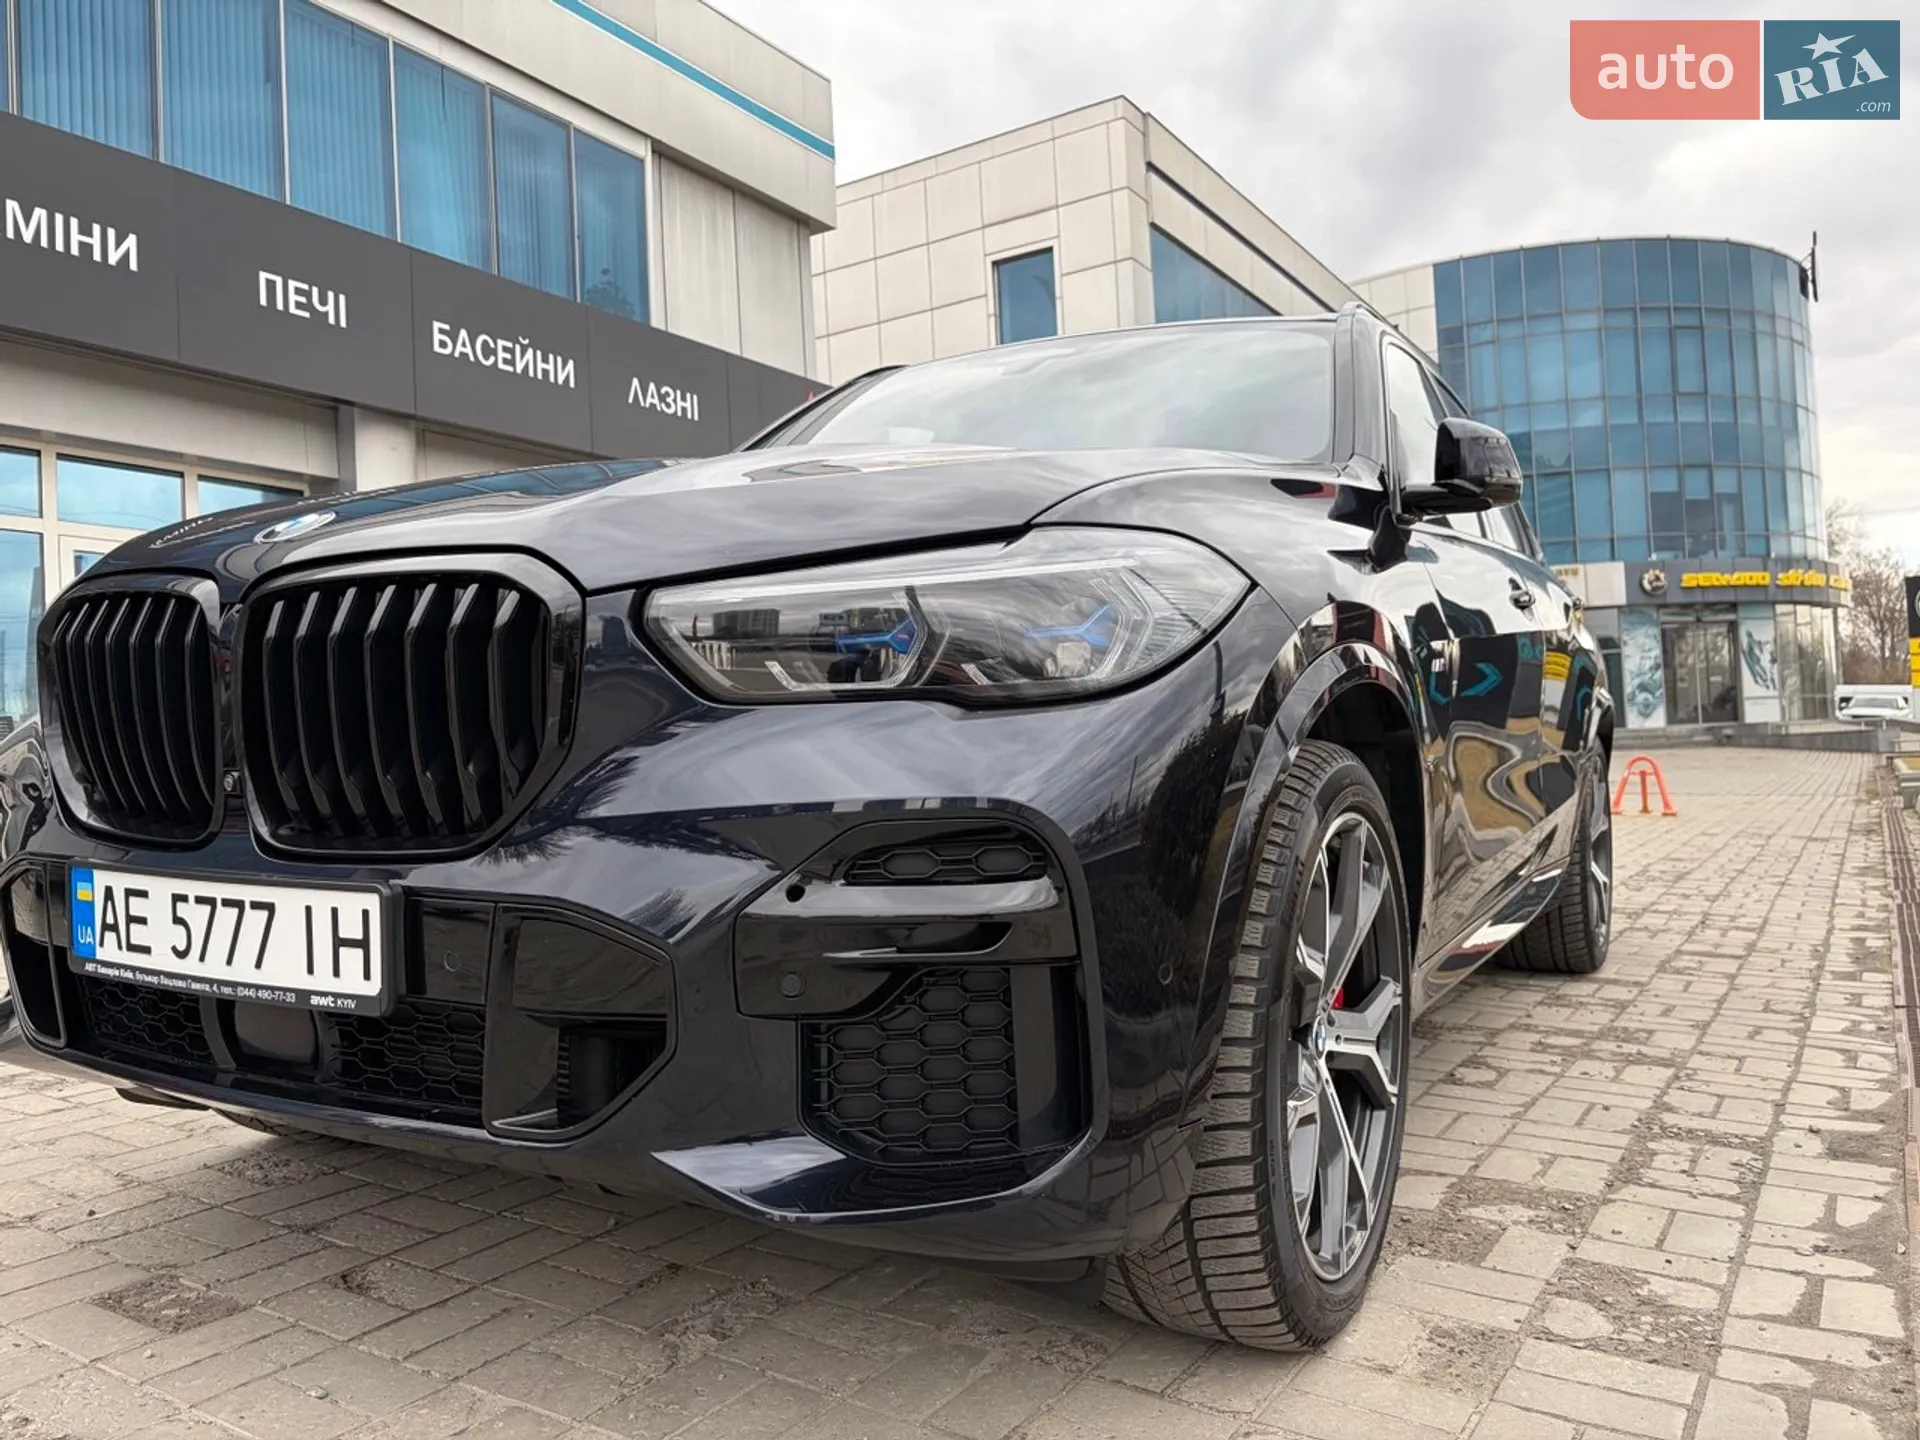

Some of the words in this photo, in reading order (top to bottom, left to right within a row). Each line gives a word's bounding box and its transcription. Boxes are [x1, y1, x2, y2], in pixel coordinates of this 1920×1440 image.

[258, 269, 347, 329] ПЕЧІ
[432, 320, 576, 389] БАСЕЙНИ
[628, 376, 699, 421] ЛАЗНІ
[77, 924, 95, 945] UA
[98, 884, 153, 956] AE
[170, 892, 277, 970] 5777
[304, 904, 372, 981] IH
